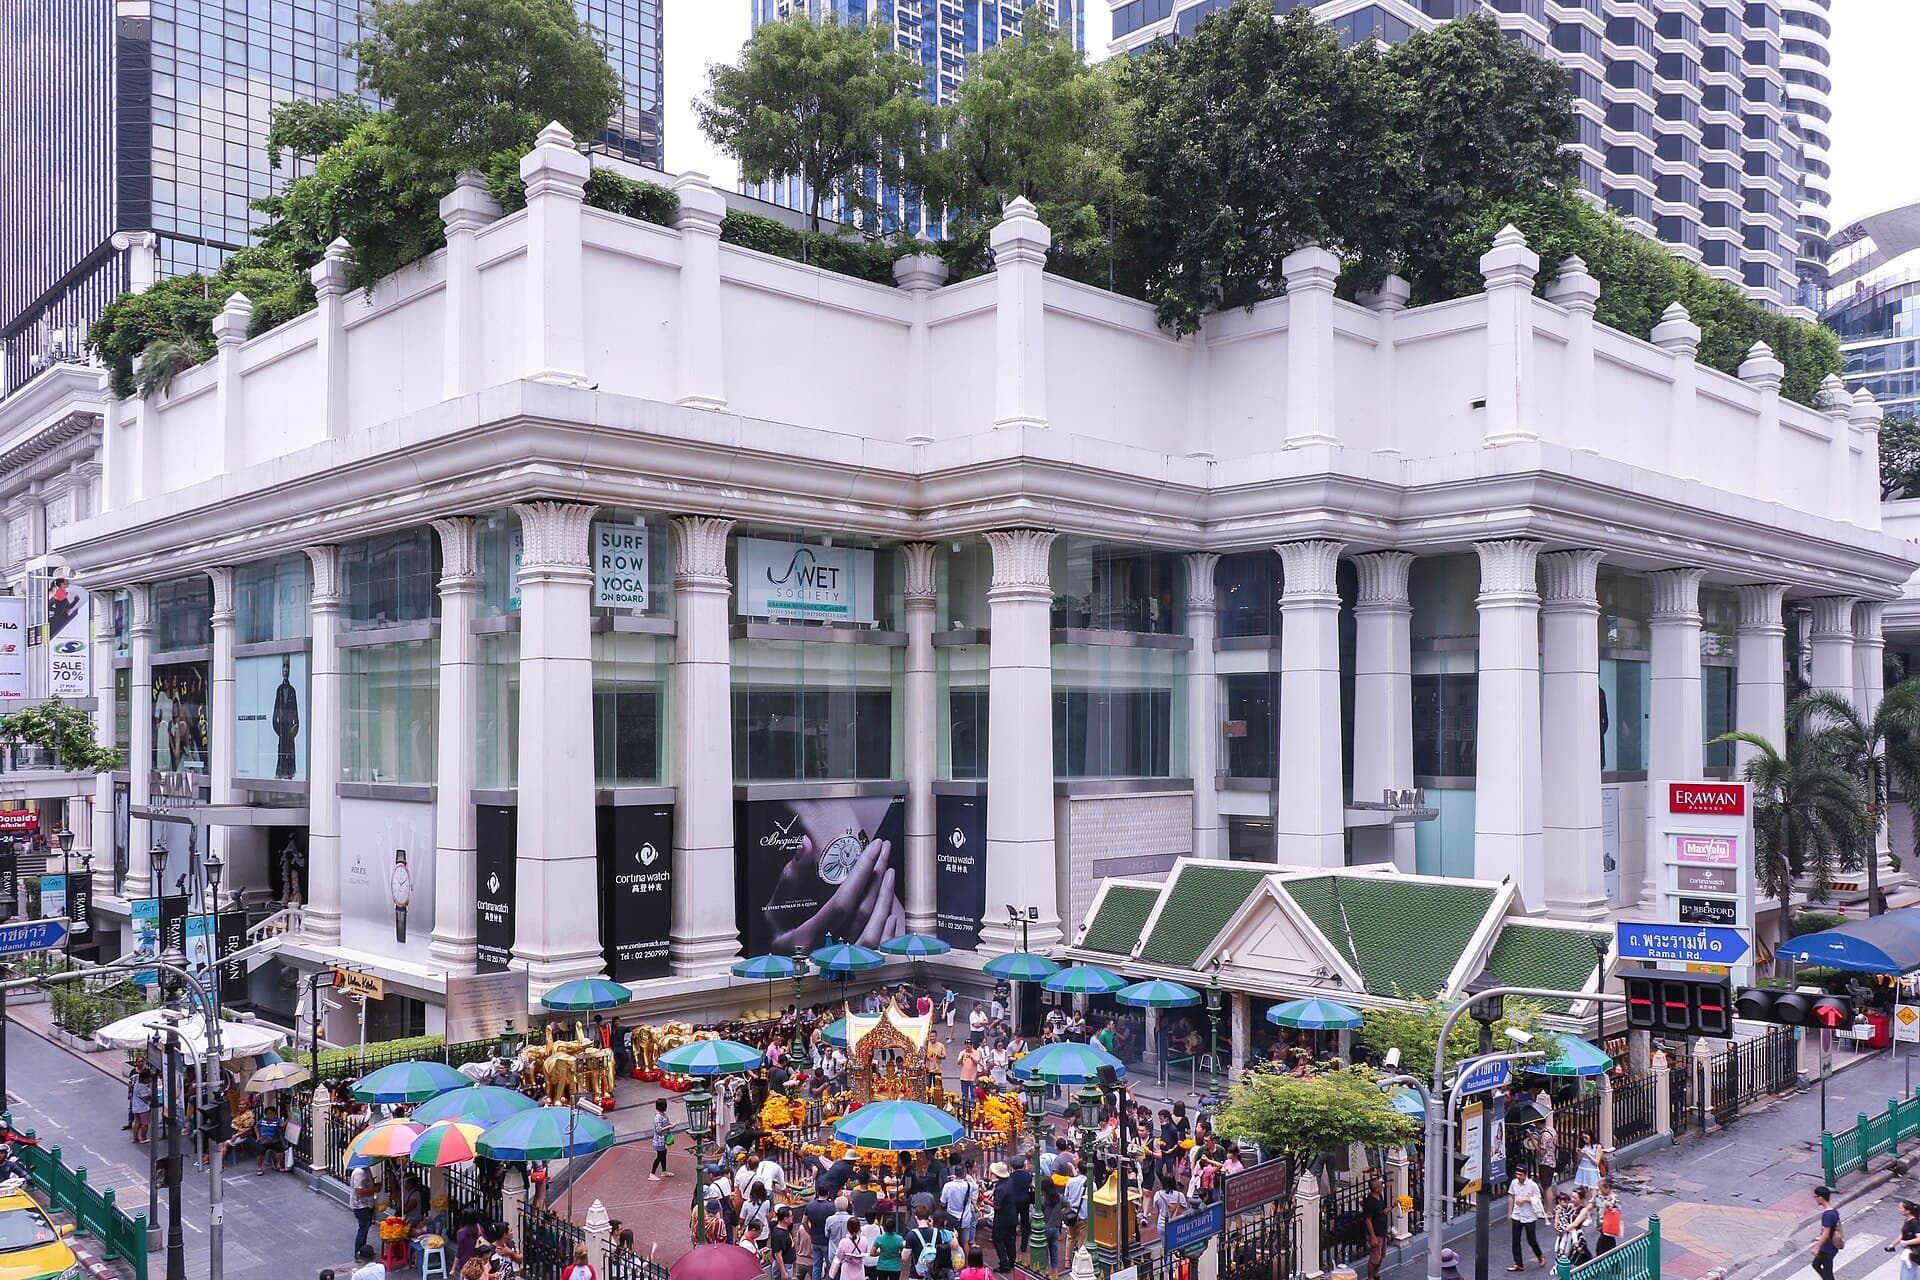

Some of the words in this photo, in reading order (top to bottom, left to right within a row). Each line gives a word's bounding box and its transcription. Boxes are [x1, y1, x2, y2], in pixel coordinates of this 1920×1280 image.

[602, 533, 643, 550] SURF
[602, 555, 643, 571] ROW
[602, 577, 643, 593] YOGA
[601, 592, 614, 601] ON
[616, 594, 644, 603] BOARD
[776, 587, 840, 601] SOCIETY
[53, 661, 82, 671] SALE
[53, 670, 84, 681] 70%
[1675, 790, 1737, 807] ERAWAN
[646, 870, 671, 882] watch
[1629, 935, 1641, 947] ถ.
[1642, 928, 1708, 951] พระรามที่
[1709, 940, 1723, 952] ๑
[620, 953, 630, 961] Tel
[635, 951, 643, 959] 02
[1648, 948, 1677, 959] Rama
[1686, 951, 1703, 960] Rd.
[217, 1216, 223, 1224] 7
